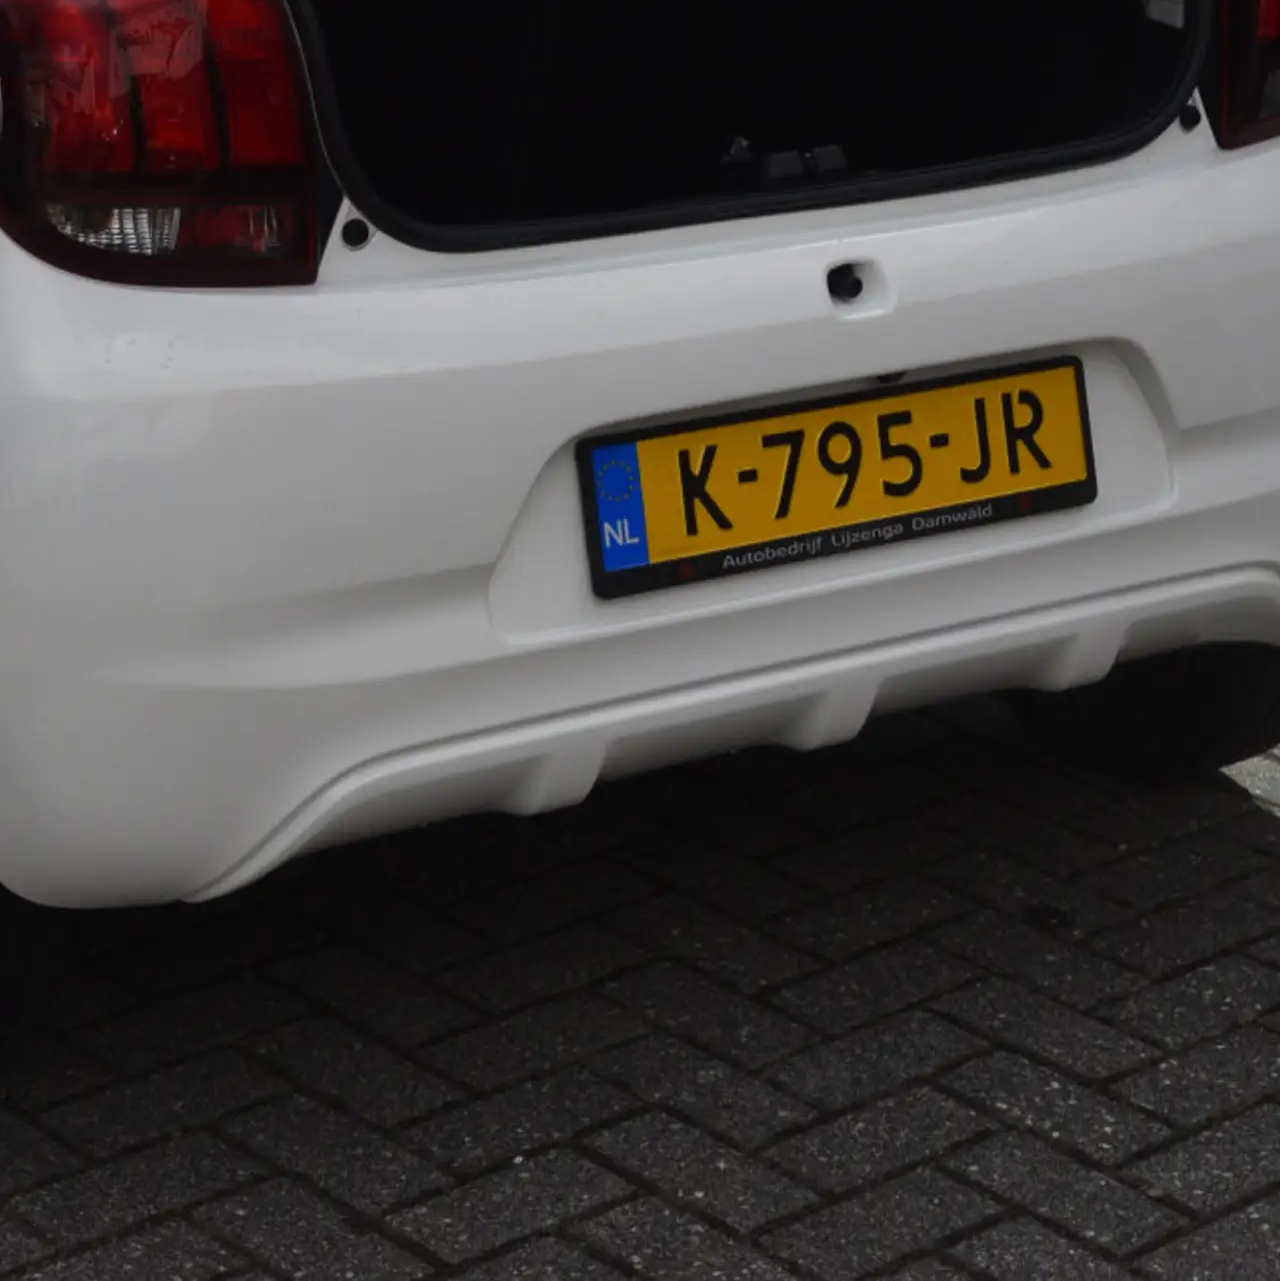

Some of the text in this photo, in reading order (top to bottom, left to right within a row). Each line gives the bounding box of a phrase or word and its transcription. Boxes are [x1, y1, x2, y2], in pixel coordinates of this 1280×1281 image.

[677, 389, 1052, 537] K-795-JR
[603, 520, 639, 548] NL
[722, 536, 824, 568] Autobedrijf
